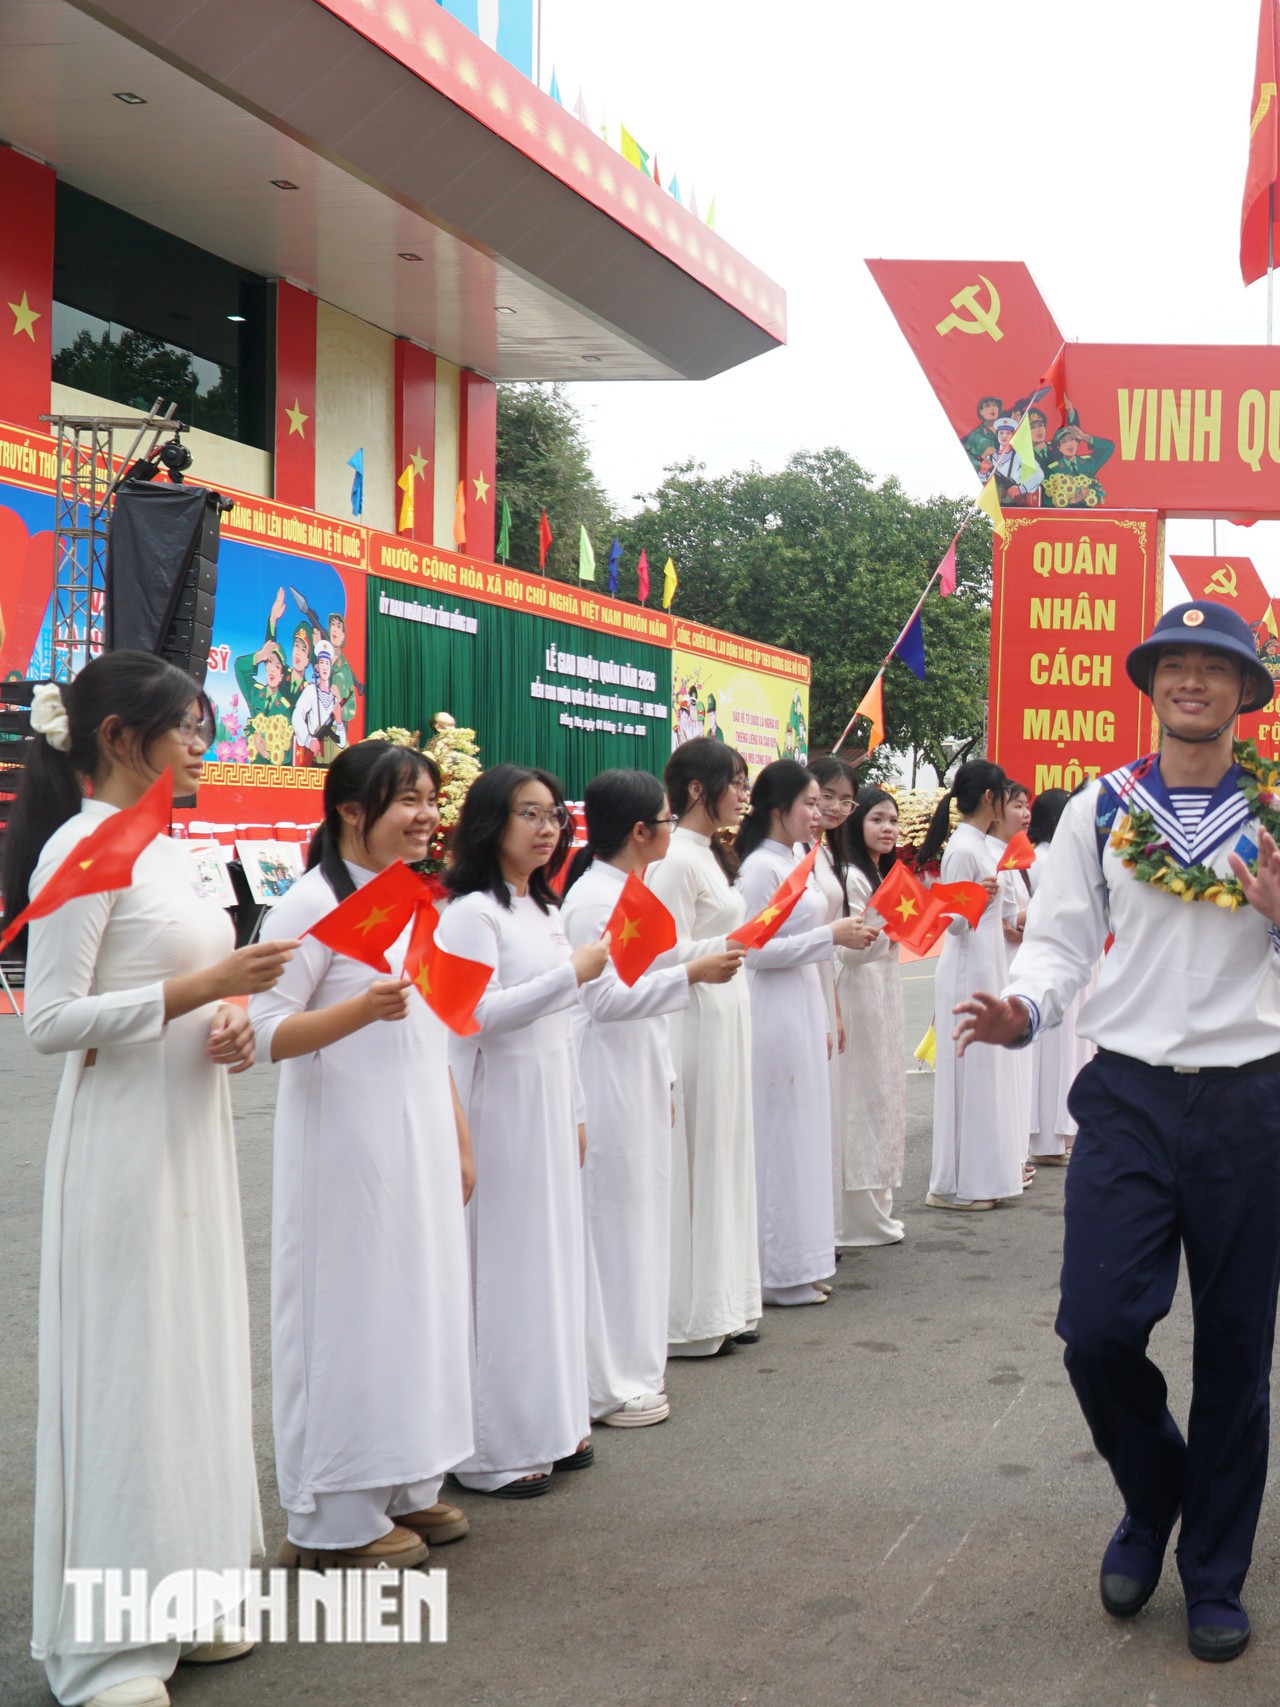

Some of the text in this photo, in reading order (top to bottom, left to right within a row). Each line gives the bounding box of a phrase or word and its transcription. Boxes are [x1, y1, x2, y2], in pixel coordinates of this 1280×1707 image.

[1117, 388, 1222, 462] VINH
[230, 501, 252, 531] HĂNG
[253, 507, 266, 534] HÁI
[267, 511, 281, 538] LÊN
[282, 515, 307, 544] ĐƯỜNG
[308, 519, 323, 549] BẢO
[323, 526, 333, 556] VỆ
[343, 531, 361, 559] QUỐC
[1032, 535, 1117, 578] QUÂN
[381, 546, 667, 639] NƯỚC CỘNG HÒA XÃ HỘI CHỦ NGHĨA VIỆT NAM MUÔN NĂM
[1029, 591, 1116, 631] NHÂN
[1029, 647, 1112, 687] CÁCH
[1022, 708, 1115, 748] MẠNG
